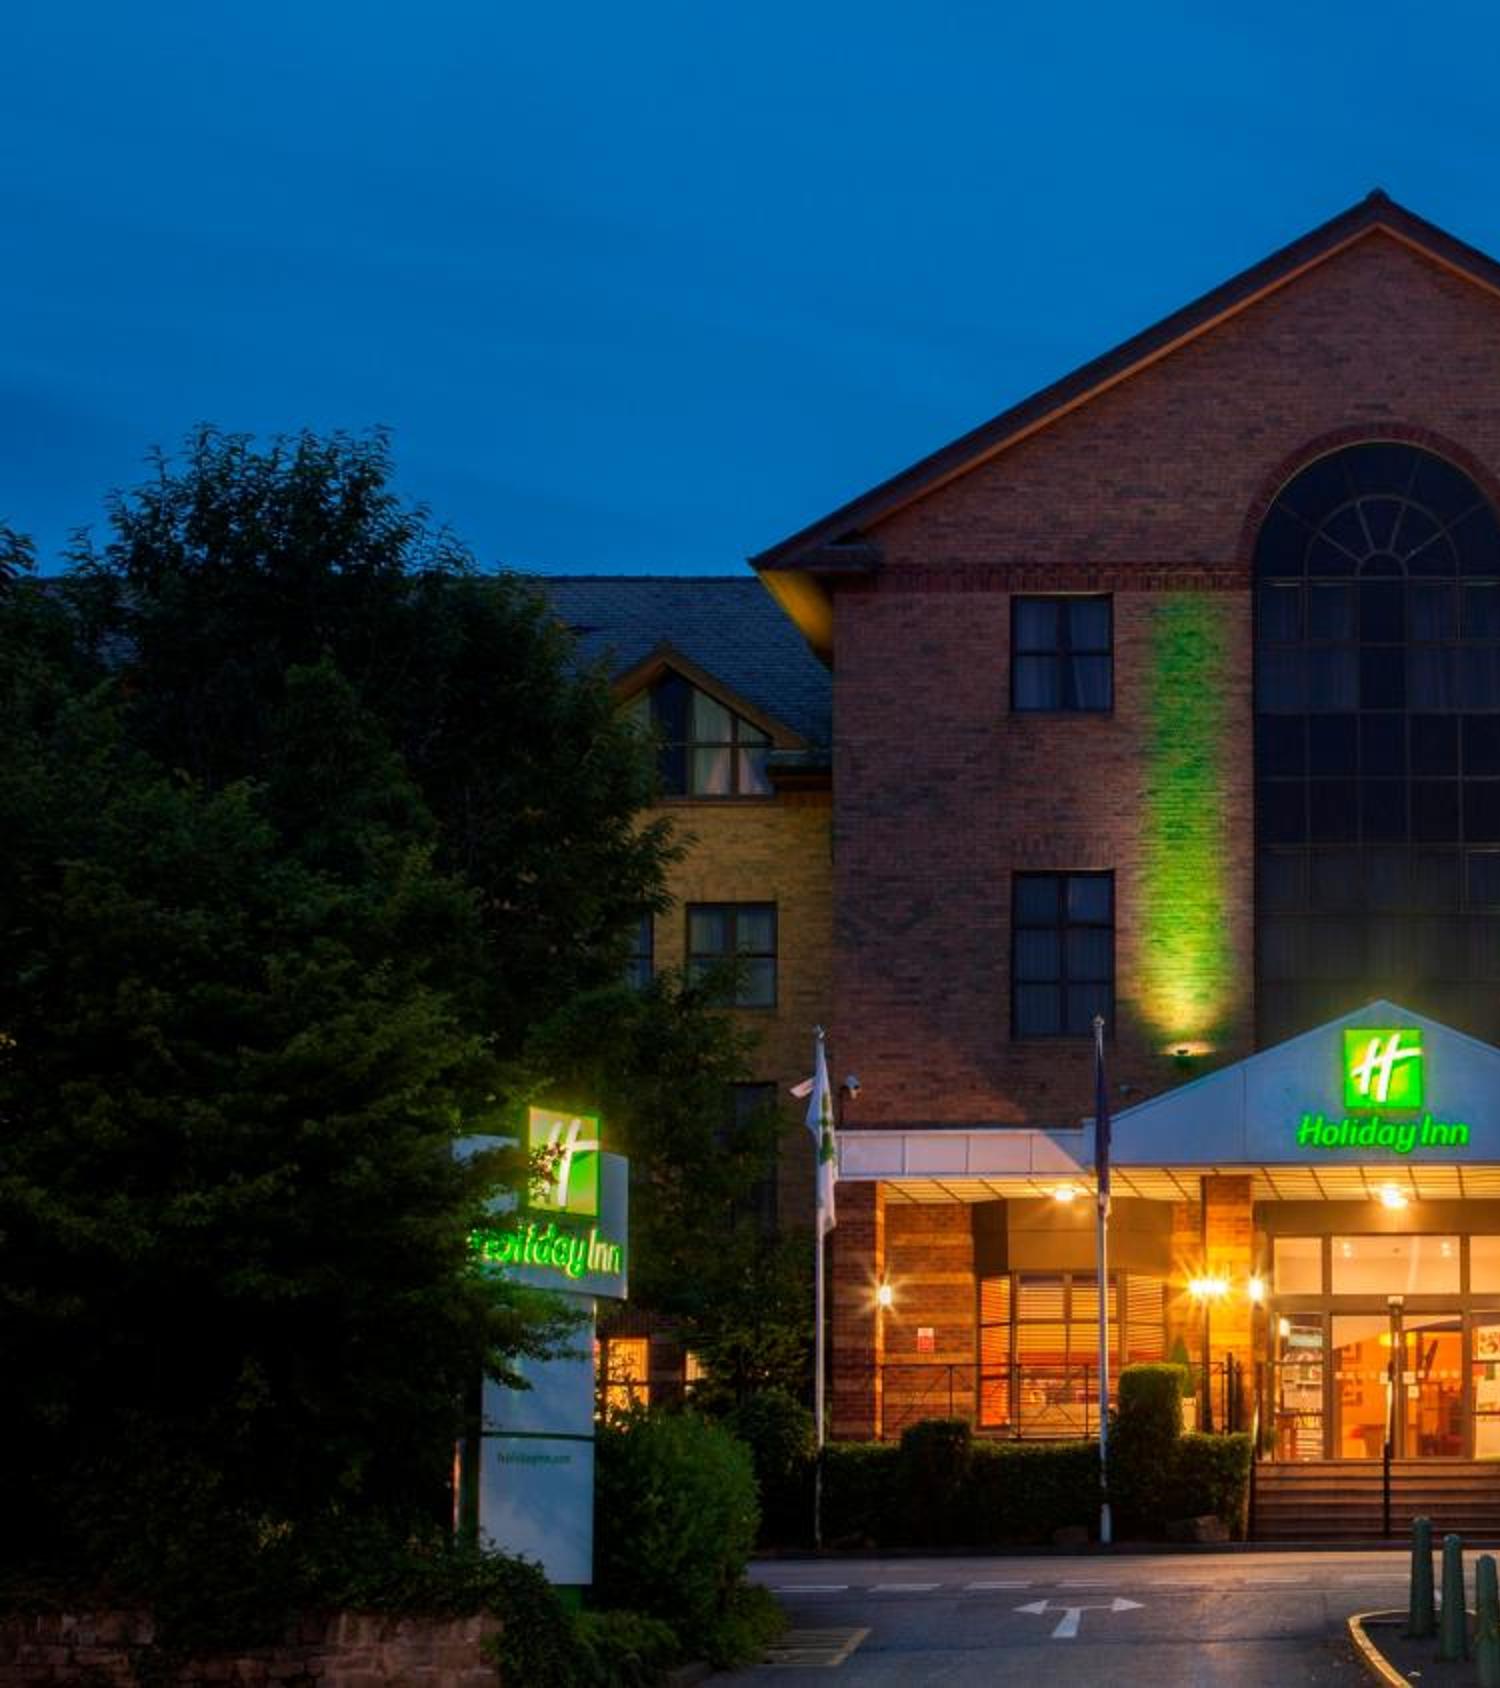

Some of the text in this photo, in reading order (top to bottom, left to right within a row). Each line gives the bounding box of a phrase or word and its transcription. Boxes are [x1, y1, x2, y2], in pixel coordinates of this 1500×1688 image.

[1298, 1113, 1469, 1153] Holiday Inn
[587, 1227, 621, 1275] Inn
